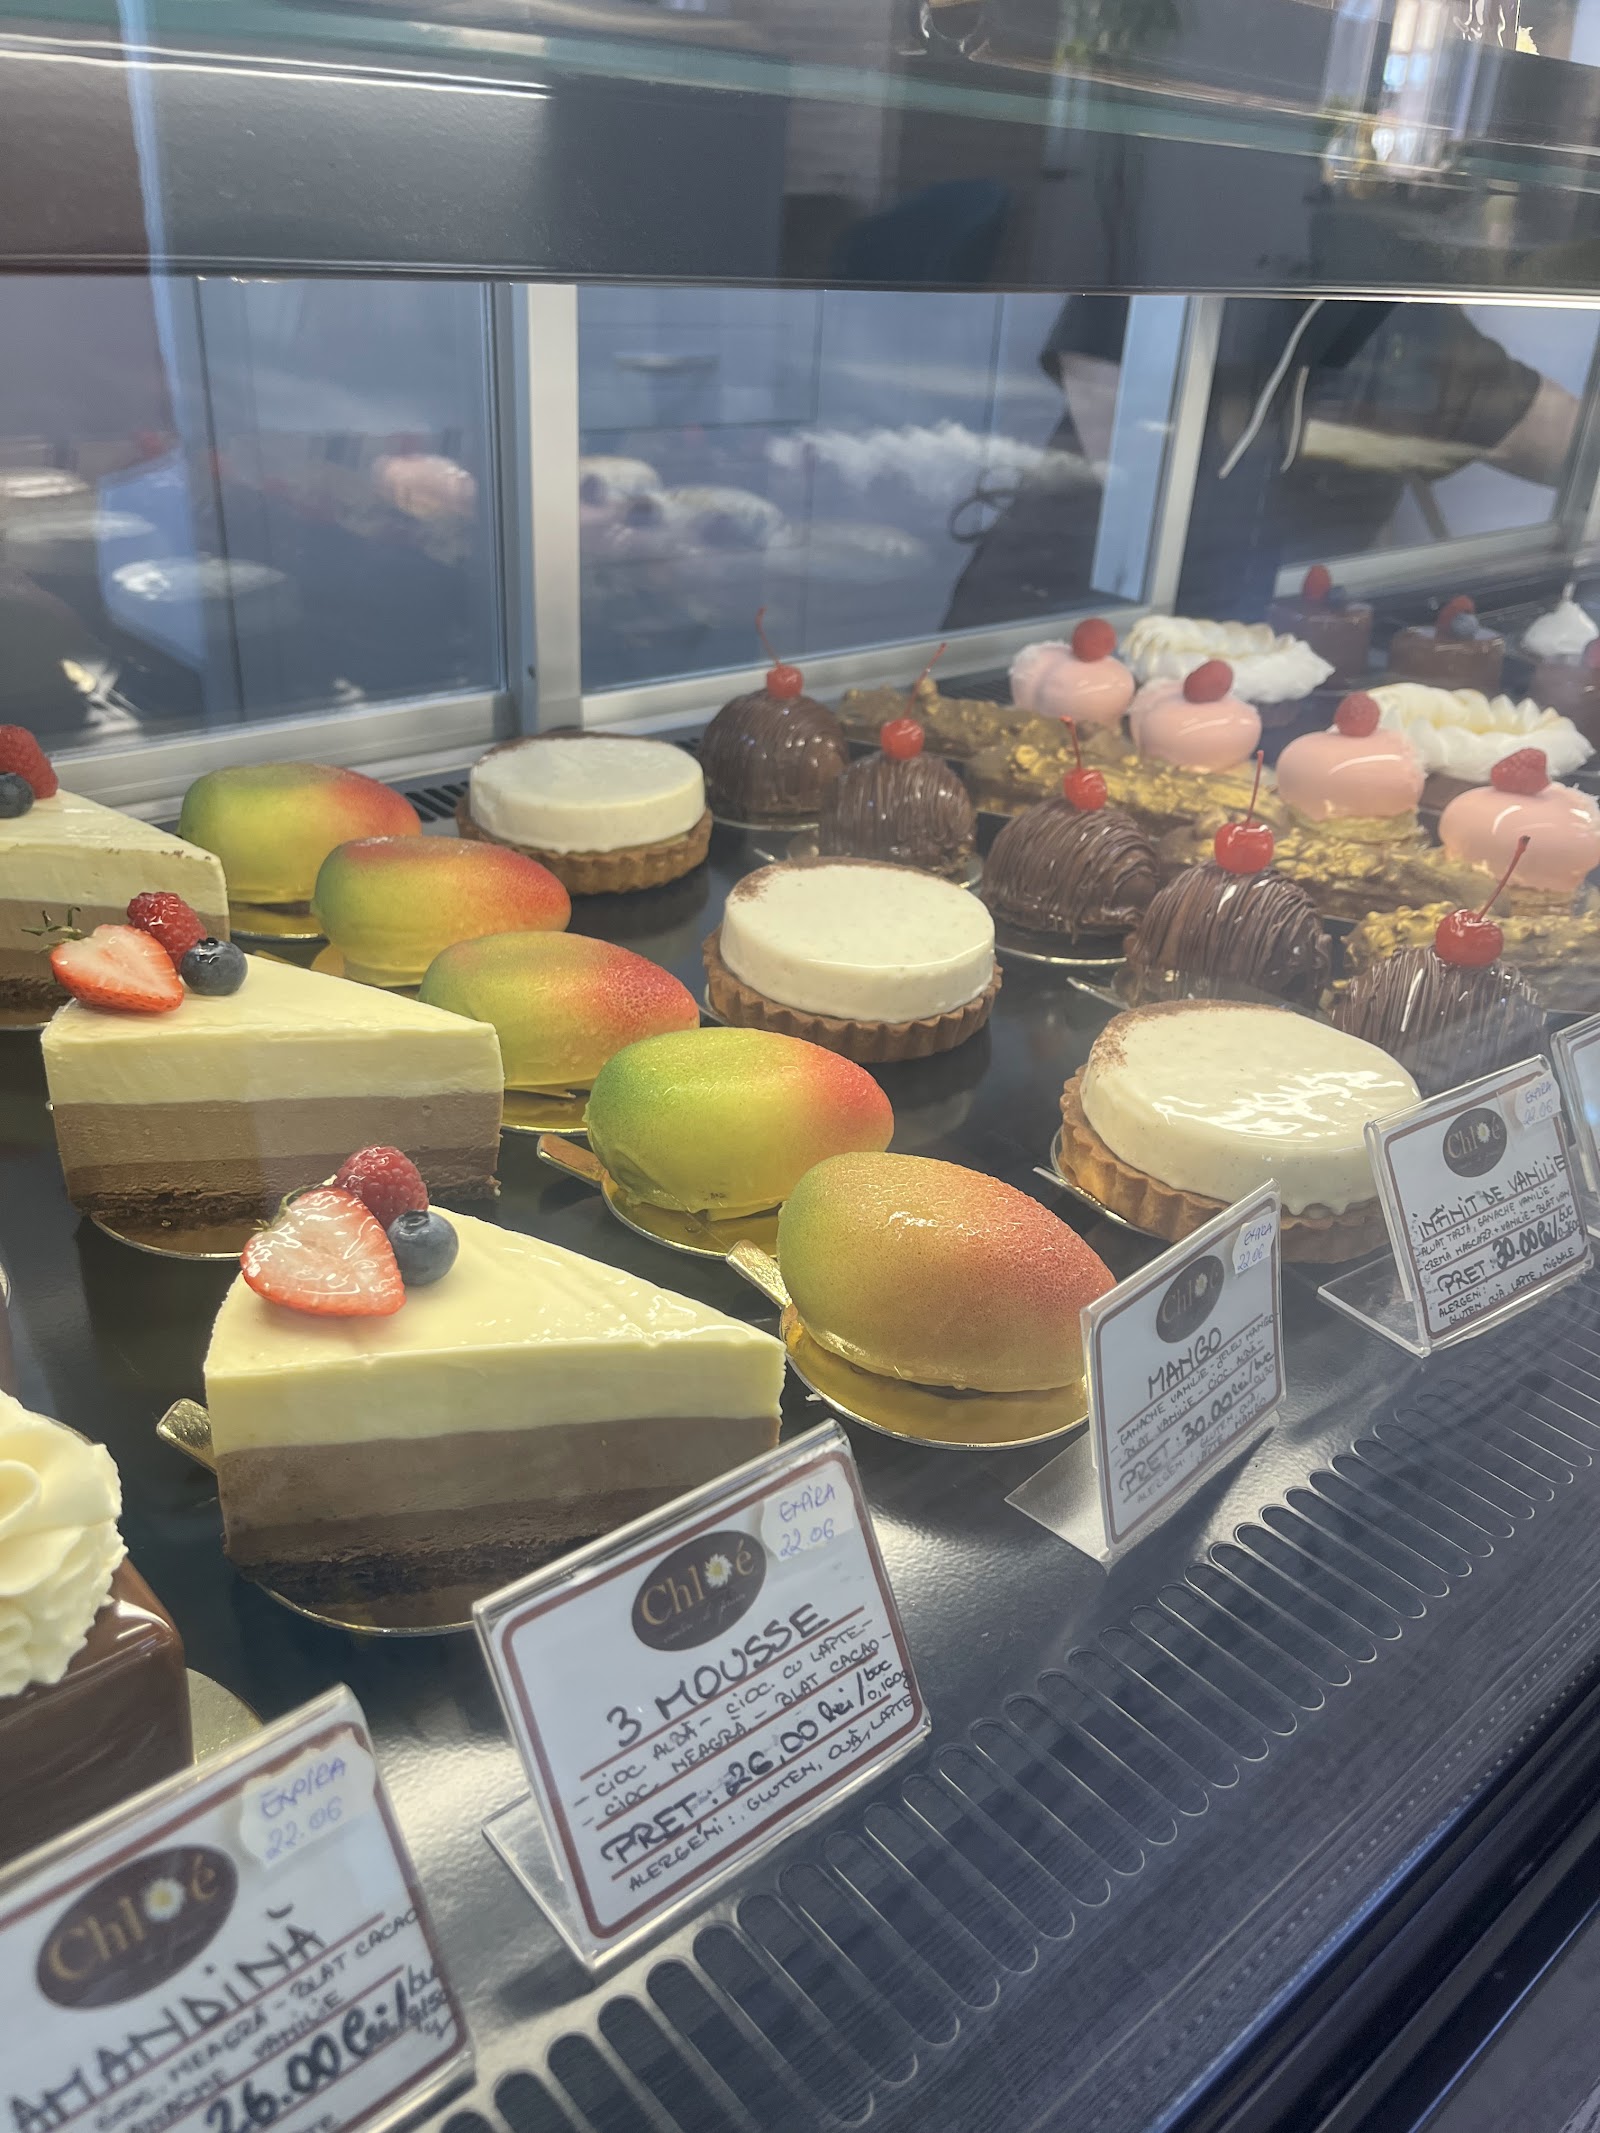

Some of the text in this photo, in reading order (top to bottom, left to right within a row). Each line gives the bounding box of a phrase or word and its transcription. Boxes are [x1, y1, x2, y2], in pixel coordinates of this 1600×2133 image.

[1483, 1186, 1505, 1206] DE
[1147, 1326, 1222, 1400] MANGO
[1119, 1402, 1166, 1446] GANACHE
[778, 1517, 835, 1558] 22.06
[640, 1539, 755, 1627] Chloé
[606, 1705, 642, 1748] 3
[654, 1602, 831, 1720] MOUSSE
[775, 1672, 819, 1707] BLAT
[829, 1638, 880, 1674] CACAO
[782, 1659, 803, 1681] CU
[265, 1794, 344, 1861] 22.06
[353, 1906, 419, 1960] CACAO
[10, 1902, 327, 2133] AMANDINĂ
